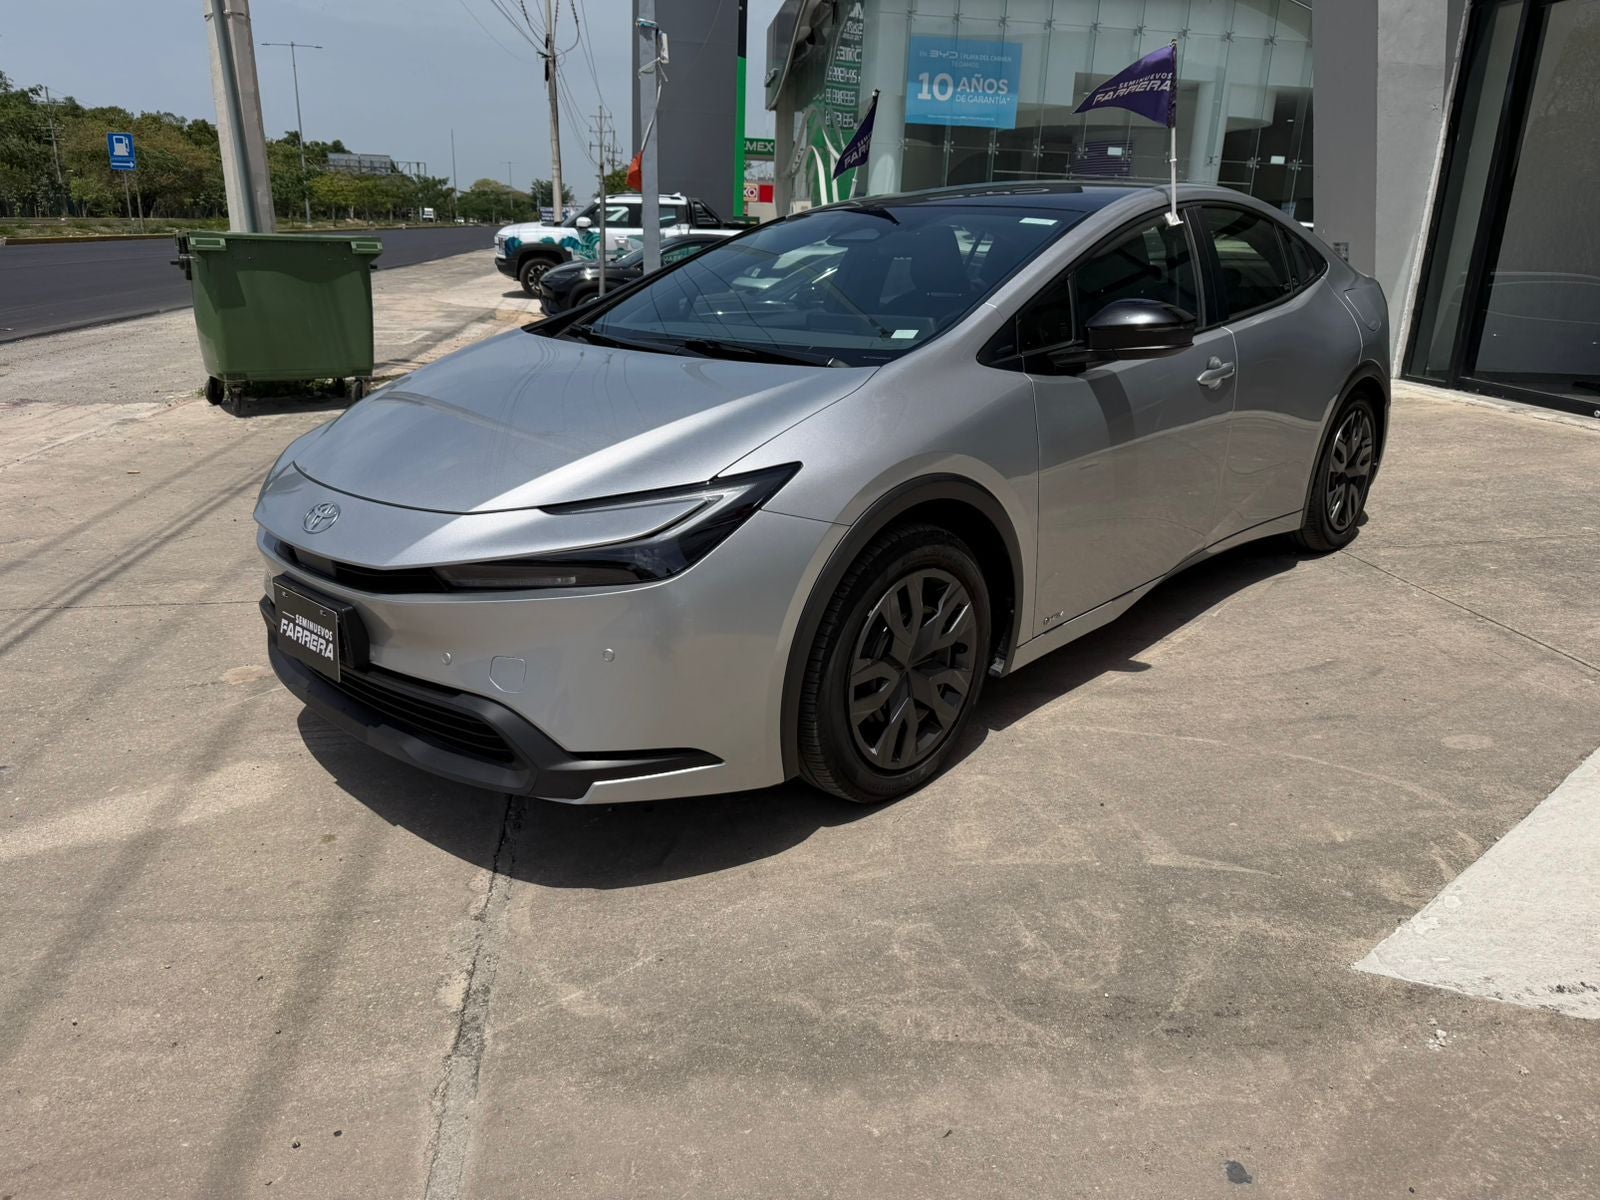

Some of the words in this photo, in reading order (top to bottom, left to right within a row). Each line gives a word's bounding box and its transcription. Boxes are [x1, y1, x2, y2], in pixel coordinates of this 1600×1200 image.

[928, 49, 959, 59] BYD
[917, 72, 954, 101] 10
[957, 73, 1009, 95] AÑOS
[1092, 80, 1171, 105] FARRERA
[955, 94, 966, 103] DE
[744, 141, 774, 152] MEX
[295, 614, 334, 641] SEMINUEVOS
[280, 618, 334, 661] FARRERA
